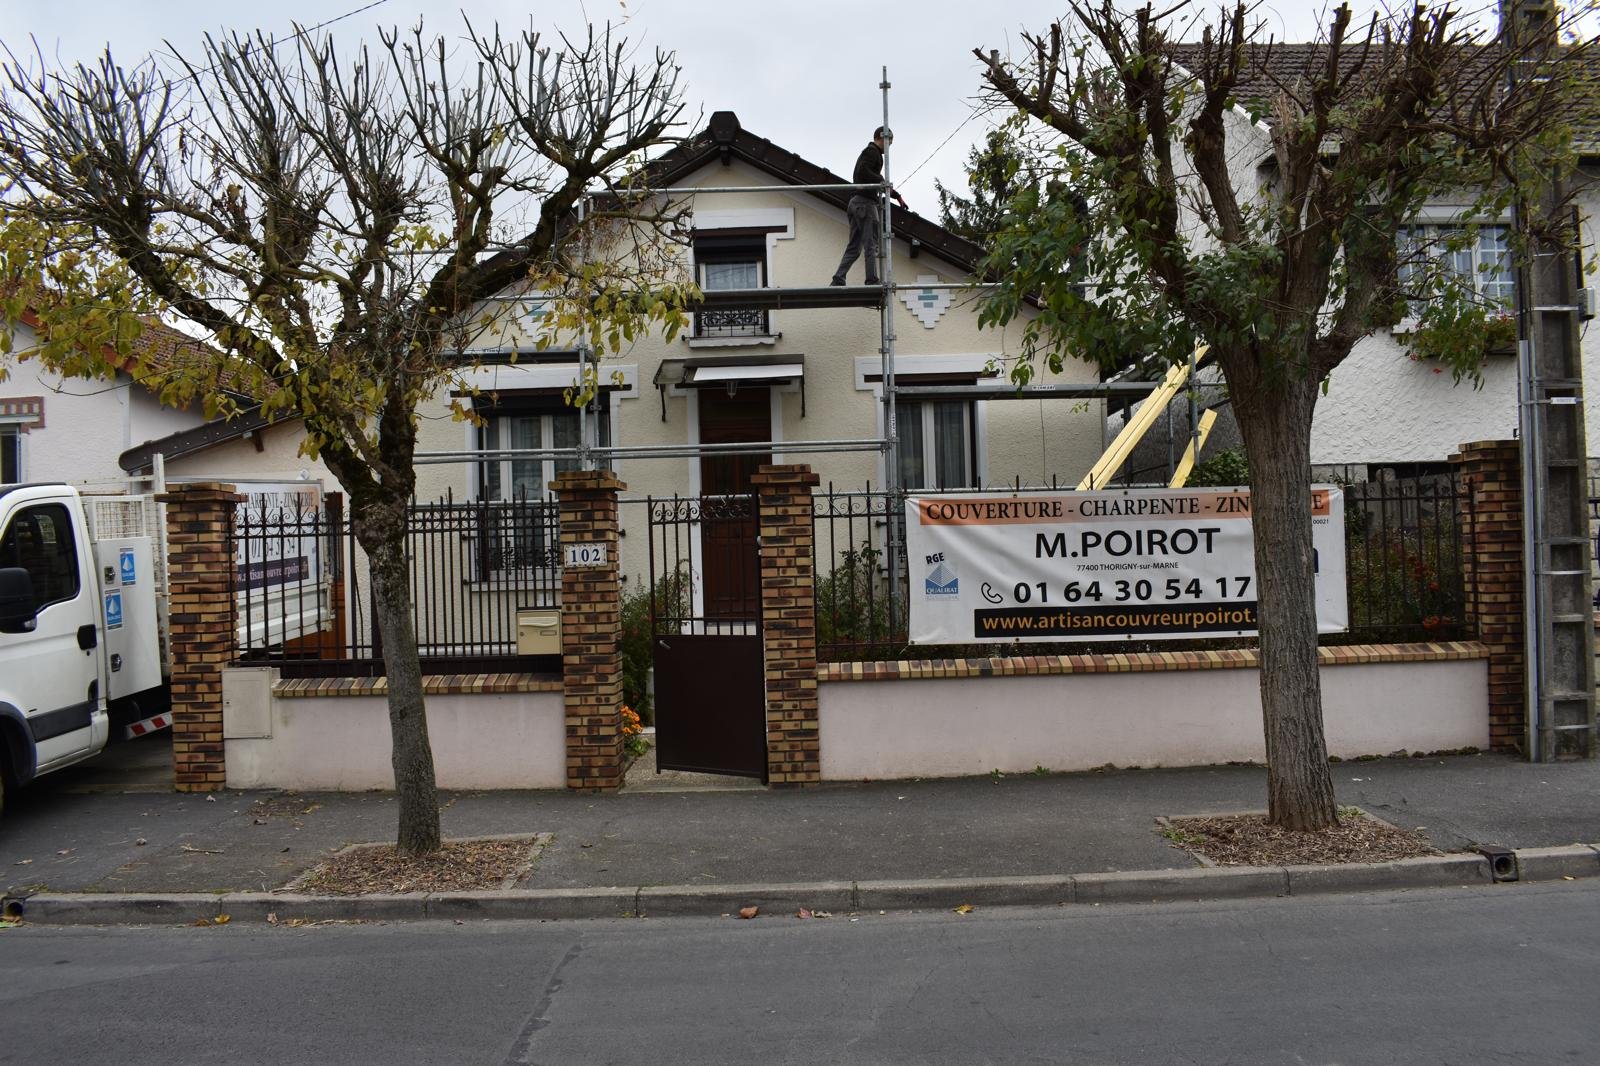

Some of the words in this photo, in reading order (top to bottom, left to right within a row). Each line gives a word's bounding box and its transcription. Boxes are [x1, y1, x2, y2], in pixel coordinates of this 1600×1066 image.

[926, 501, 1063, 520] COUVERTURE
[1079, 496, 1200, 517] CHARPENTE
[1215, 496, 1251, 513] ZIN
[1036, 528, 1220, 558] M.POIROT
[571, 548, 601, 563] 102
[925, 552, 945, 565] RGE
[1076, 564, 1099, 572] 77400
[1100, 562, 1179, 571] THORIGNY-sur-MARNE
[1013, 582, 1048, 603] 01
[1063, 580, 1103, 602] 64
[1115, 579, 1152, 601] 30
[1165, 578, 1203, 600] 54
[1215, 576, 1251, 598] 17
[983, 606, 1257, 630] www.artisancouvreurpoirot.
